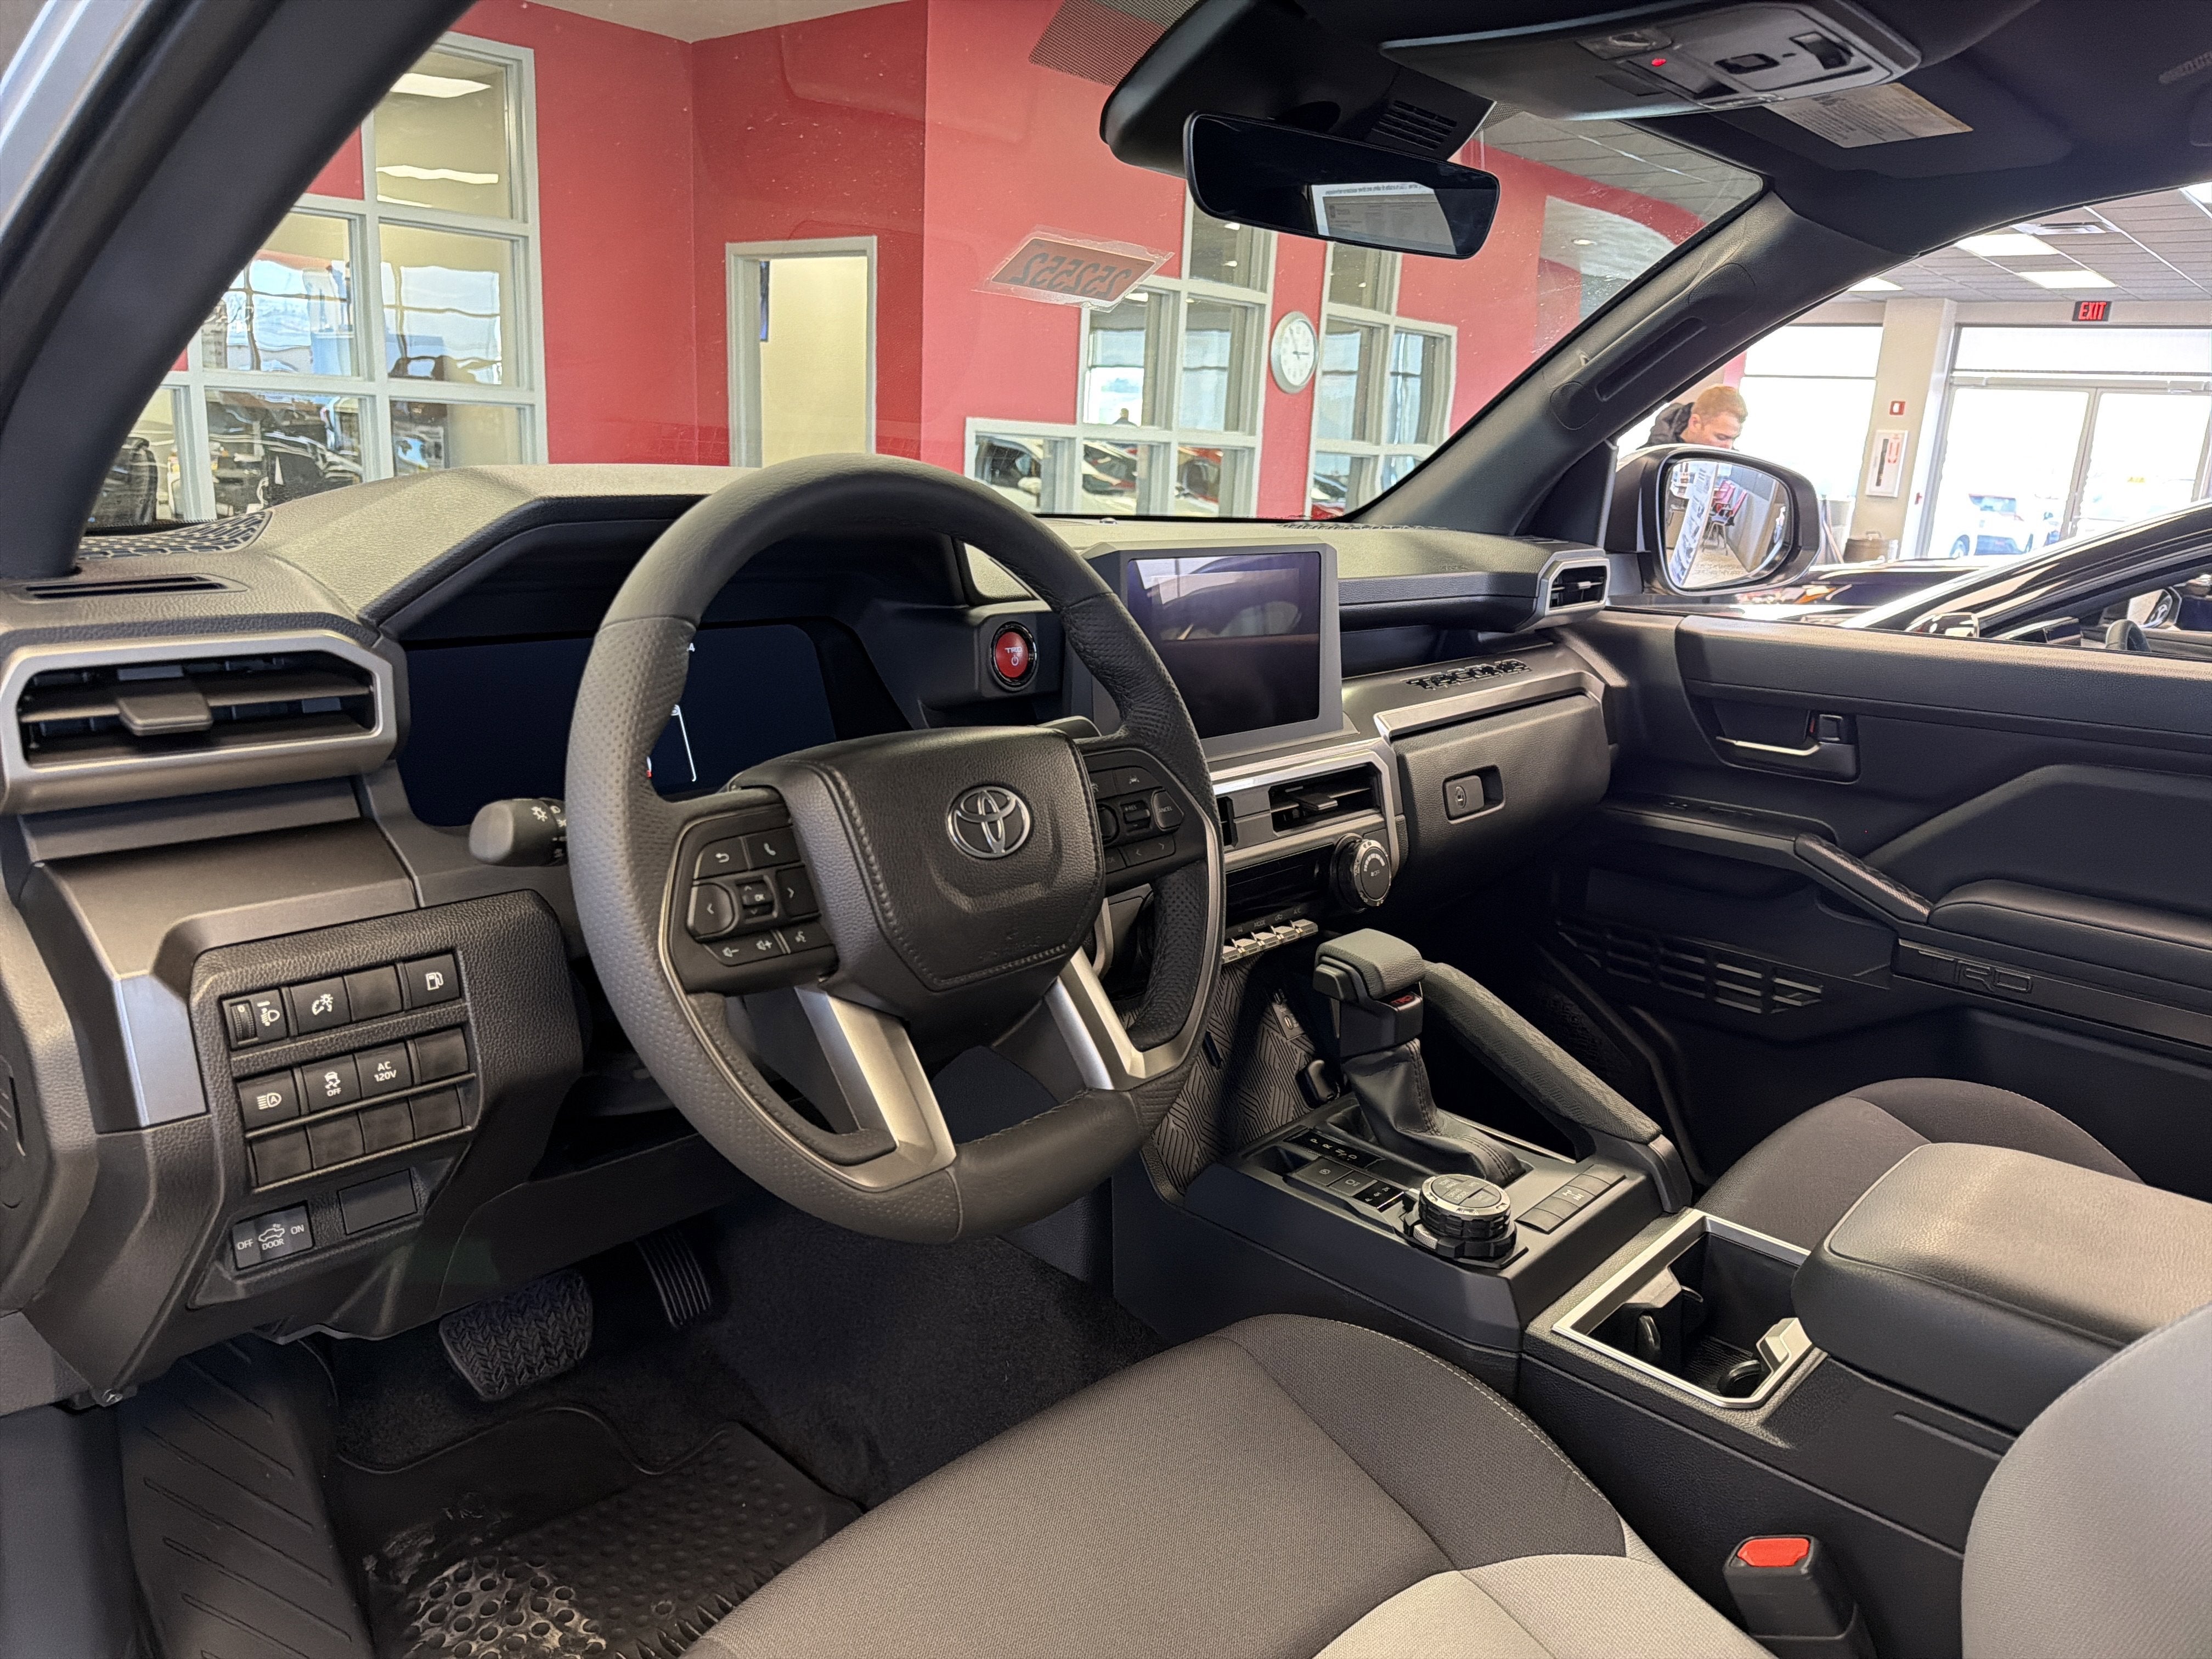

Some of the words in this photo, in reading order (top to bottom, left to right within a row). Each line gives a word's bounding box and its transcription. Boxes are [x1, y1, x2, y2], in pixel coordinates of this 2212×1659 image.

[2078, 302, 2107, 320] EXIT
[1918, 950, 2033, 994] TRD
[377, 1061, 391, 1070] AC
[374, 1069, 397, 1082] 120V
[327, 1087, 341, 1097] OFF
[290, 1224, 304, 1235] ON
[237, 1237, 253, 1250] OFF
[262, 1238, 285, 1250] DOOR
